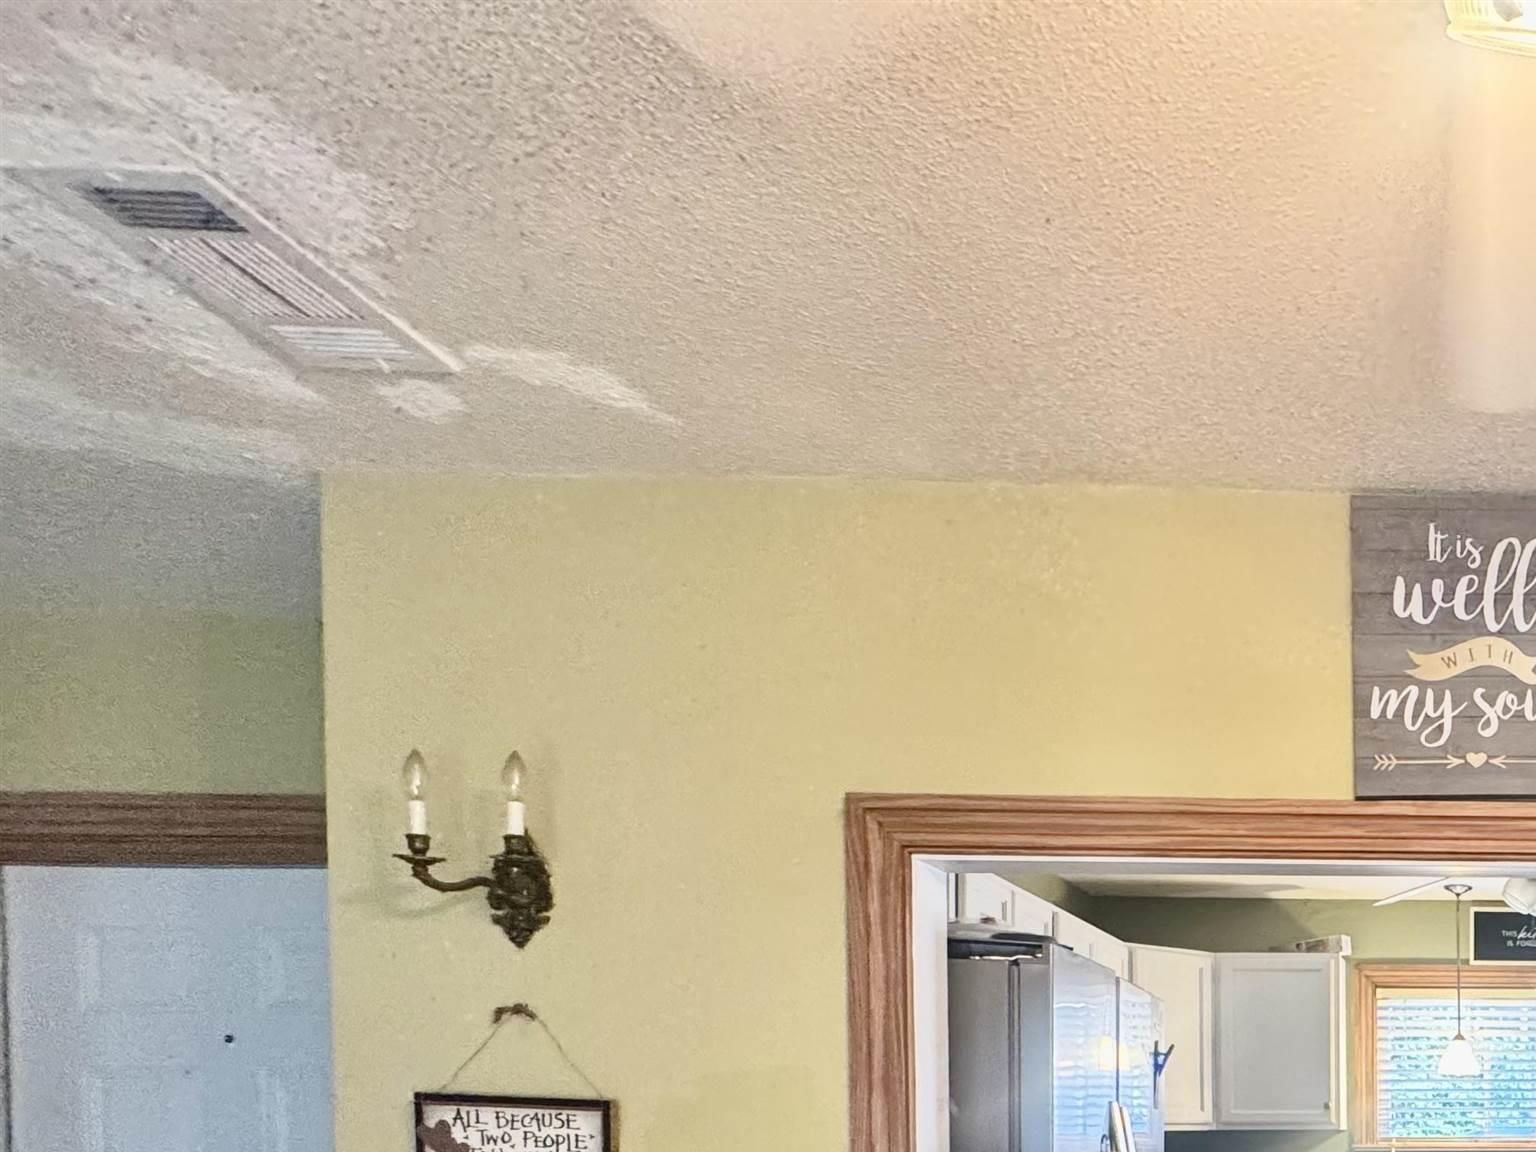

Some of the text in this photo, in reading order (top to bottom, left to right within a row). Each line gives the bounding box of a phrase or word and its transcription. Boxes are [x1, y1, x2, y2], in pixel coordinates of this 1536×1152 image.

[1428, 523, 1484, 569] It is
[1441, 643, 1514, 669] WITH
[1370, 685, 1468, 747] my
[452, 1107, 581, 1132] ALL BECAUSE
[477, 1129, 588, 1152] TWO PEOPLE
